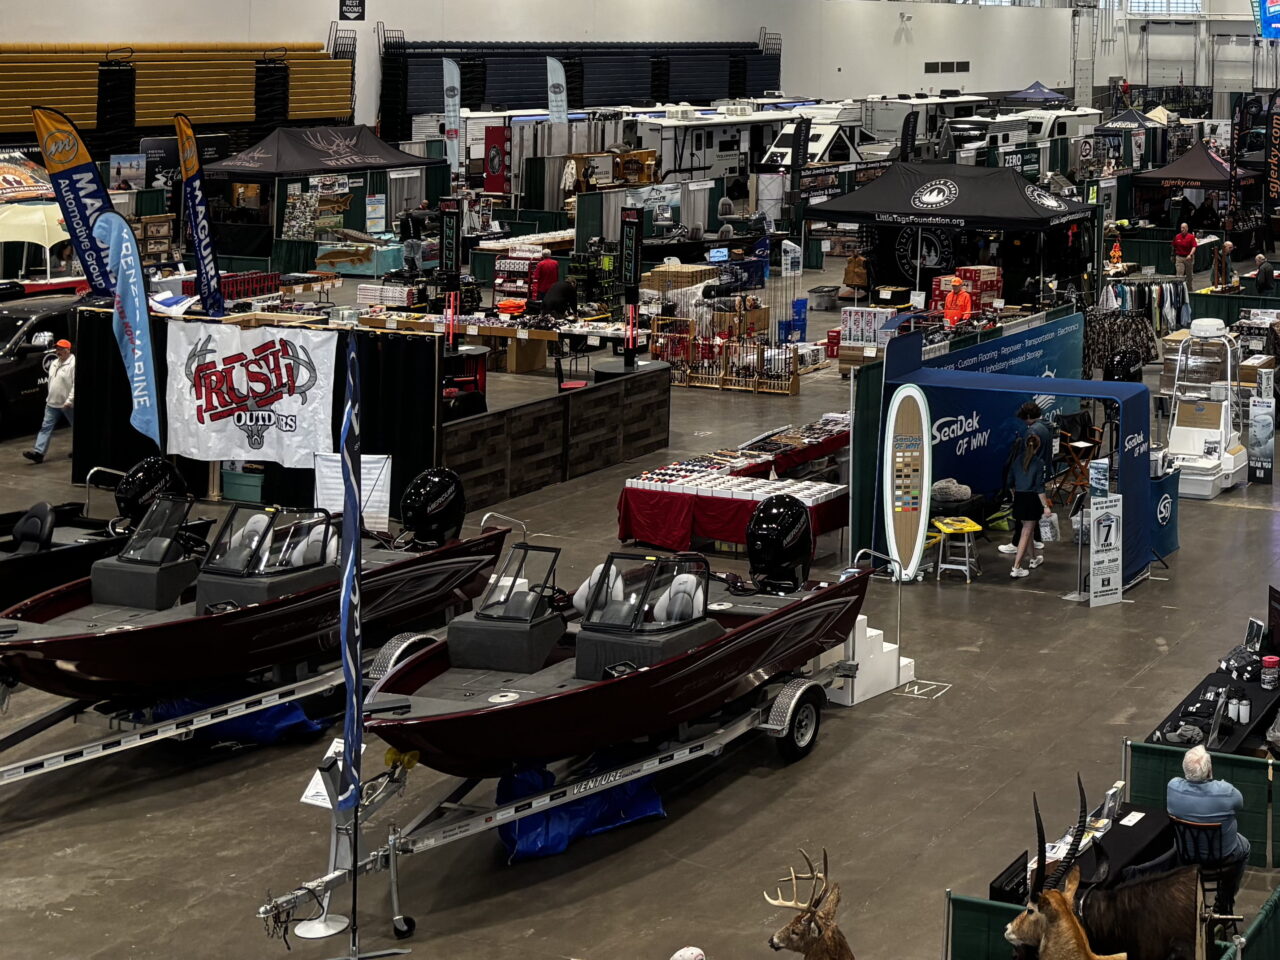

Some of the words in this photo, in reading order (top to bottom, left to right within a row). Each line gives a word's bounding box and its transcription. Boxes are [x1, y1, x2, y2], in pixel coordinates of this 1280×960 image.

[1005, 154, 1022, 167] ZERO
[1160, 179, 1201, 188] sgjerky.com
[875, 213, 965, 227] LittleTagsFoundation.org
[58, 179, 90, 251] Automotive
[85, 250, 106, 289] Group
[192, 179, 218, 293] MAGUIRE
[957, 356, 978, 369] Custom
[978, 350, 998, 363] Flooring
[1001, 343, 1022, 355] Repower
[1025, 330, 1055, 347] Transportation
[1057, 322, 1079, 338] Electronics
[1025, 349, 1043, 362] Storage
[201, 348, 288, 414] RUSH
[234, 410, 297, 433] OUTDRS
[932, 411, 980, 446] SeaDek
[956, 438, 968, 456] OF
[970, 429, 991, 452] WNY
[1124, 430, 1145, 453] SeaDek
[427, 483, 456, 513] MERCURY
[1102, 524, 1113, 543] 7
[572, 769, 623, 795] VENTURE
